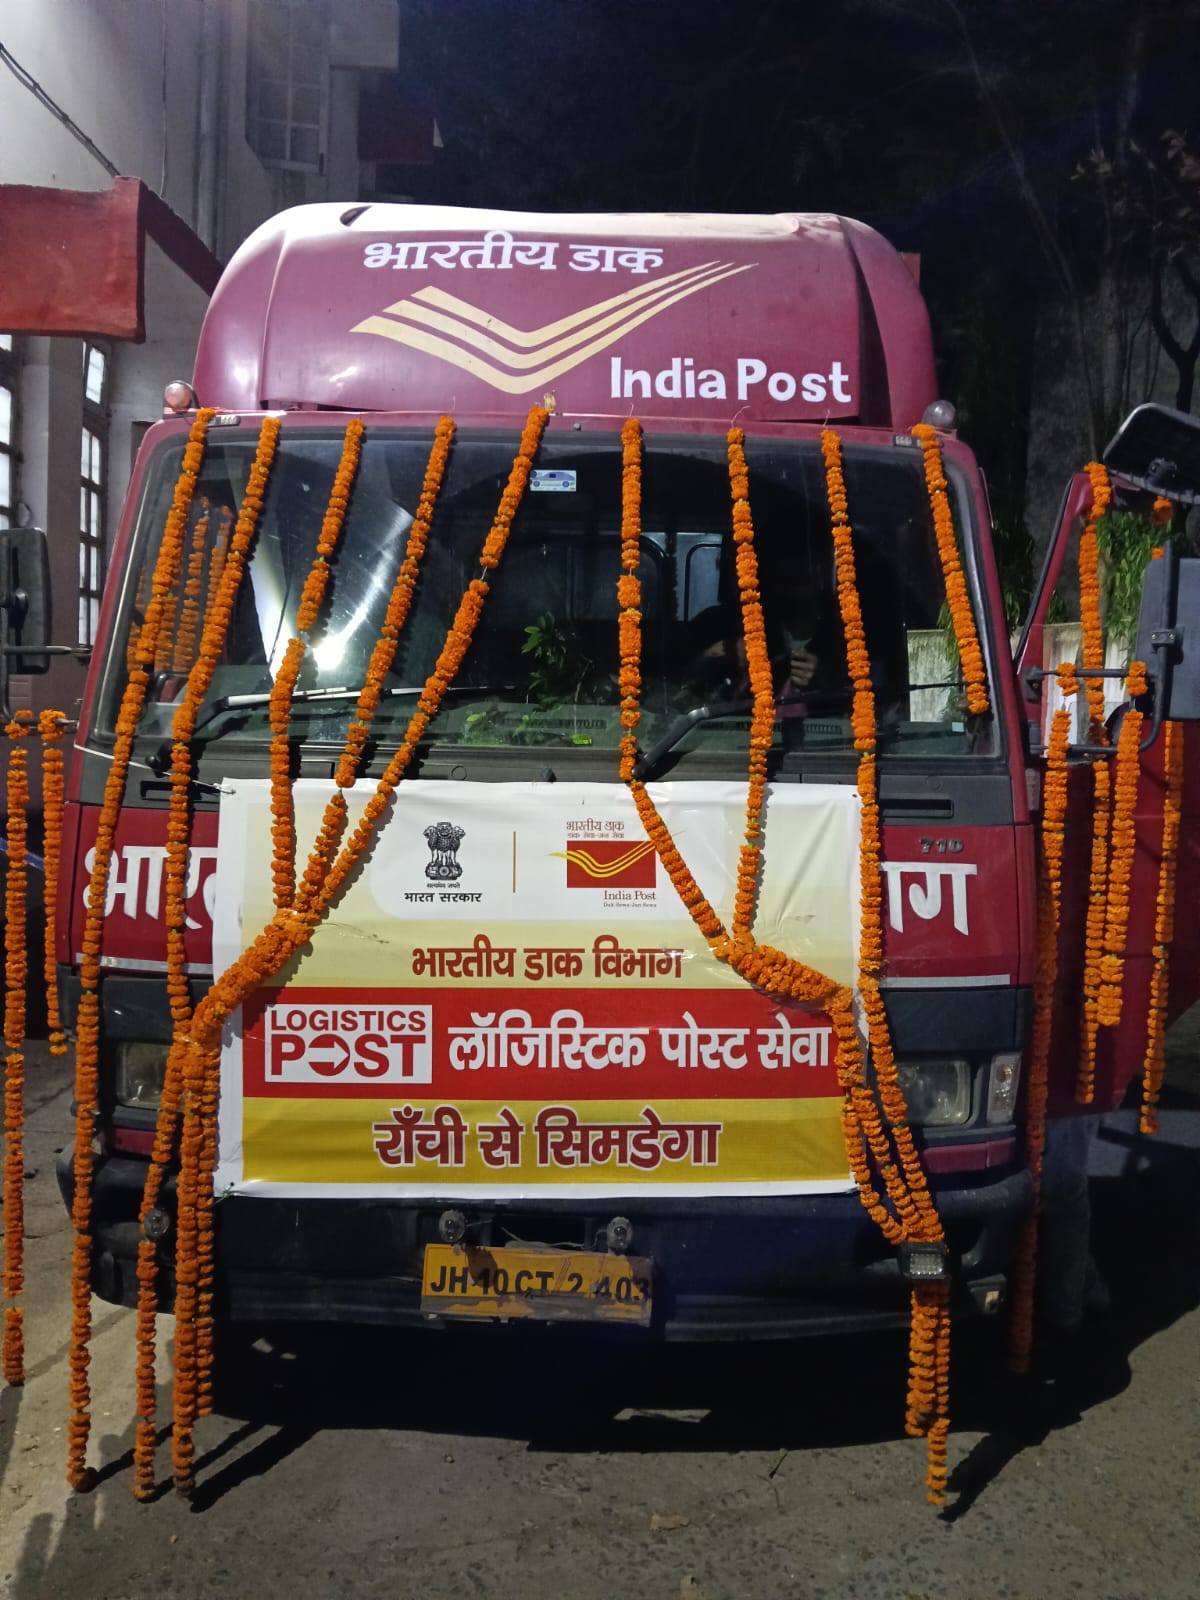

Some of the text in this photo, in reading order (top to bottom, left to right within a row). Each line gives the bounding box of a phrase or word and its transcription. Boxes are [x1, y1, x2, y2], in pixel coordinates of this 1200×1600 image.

[362, 230, 664, 275] भारतीय डाक
[610, 356, 851, 404] India Post
[566, 817, 602, 831] भारतीय
[404, 892, 483, 902] भारत सरकार
[604, 889, 657, 900] India Post
[412, 934, 685, 981] भारतीय डाक विभाग
[271, 1009, 427, 1032] LOGISTICS
[447, 1009, 833, 1071] लॉजिस्टिक पोस्ट सेवा
[271, 1033, 427, 1078] POST
[373, 1104, 723, 1172] राँची से सिमडेगा
